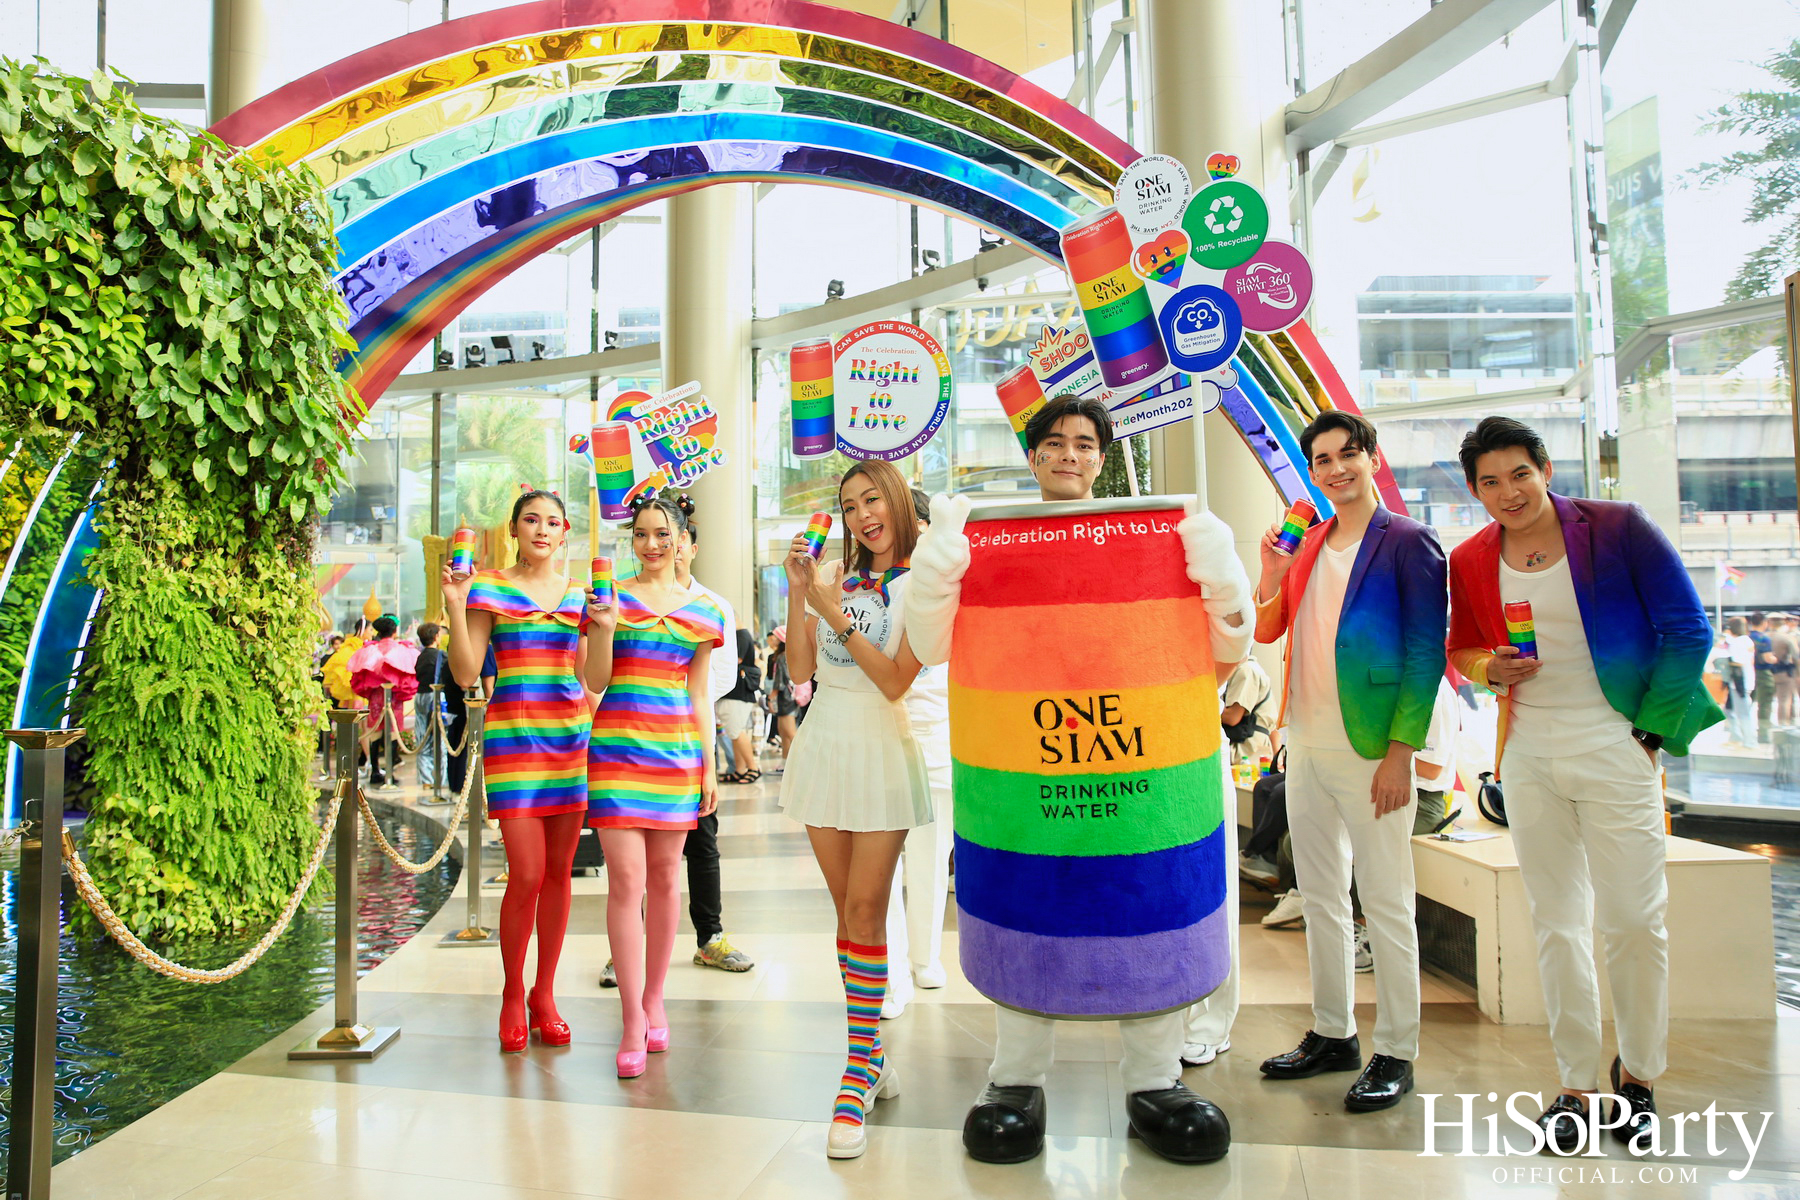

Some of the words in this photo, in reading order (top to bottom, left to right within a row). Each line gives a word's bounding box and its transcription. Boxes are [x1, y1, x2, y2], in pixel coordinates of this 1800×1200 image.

[1130, 162, 1140, 170] THE
[1166, 159, 1178, 168] CAN
[1119, 172, 1129, 186] SAVE
[1135, 174, 1164, 190] ONE
[1178, 168, 1188, 182] SAVE
[1138, 183, 1172, 200] SIAM
[1138, 197, 1172, 210] DRINKING
[1140, 206, 1163, 215] WATER
[1174, 198, 1188, 220] WORLD
[1090, 223, 1104, 236] Right
[1196, 244, 1215, 253] 100%
[1218, 234, 1258, 248] Recyclable
[1093, 276, 1118, 294] ONE
[1236, 275, 1260, 286] SIAM
[1237, 282, 1266, 294] PIWAT
[1096, 283, 1126, 302] SIAM
[1101, 300, 1130, 315] DRINKING
[1103, 309, 1124, 320] WATER
[854, 326, 875, 338] SAVE
[898, 325, 925, 340] WORLD
[1184, 333, 1216, 342] Greenhouse
[837, 338, 852, 352] CAN
[926, 340, 940, 354] CAN
[1192, 338, 1220, 347] Mitigation
[876, 347, 917, 355] Celebration:
[1040, 332, 1088, 372] SHOO
[849, 359, 920, 388] Right
[938, 356, 949, 378] SAVE
[801, 383, 818, 391] ONE
[942, 382, 950, 398] THE
[1054, 369, 1100, 398] #ONESIA
[638, 403, 652, 412] The
[654, 385, 696, 406] Celebration:
[802, 390, 822, 398] SIAM
[869, 389, 892, 409] to
[634, 396, 714, 444] Right
[848, 406, 908, 431] Love
[929, 402, 947, 432] WORLD
[1110, 398, 1192, 428] PrideMonth202
[670, 436, 698, 458] to
[912, 434, 928, 448] CAN
[838, 442, 864, 458] WORLD
[888, 446, 909, 459] SAVE
[659, 448, 726, 487] Love
[970, 527, 1067, 548] Celebration
[1073, 522, 1126, 545] Right
[1130, 522, 1147, 534] to
[1152, 519, 1178, 534] Lov
[870, 596, 884, 610] SAVE
[879, 618, 888, 642] WORLD
[1034, 694, 1123, 730] ONE
[1040, 726, 1145, 764] SIAM
[1041, 779, 1149, 799] DRINKING
[1042, 802, 1118, 819] WATER
